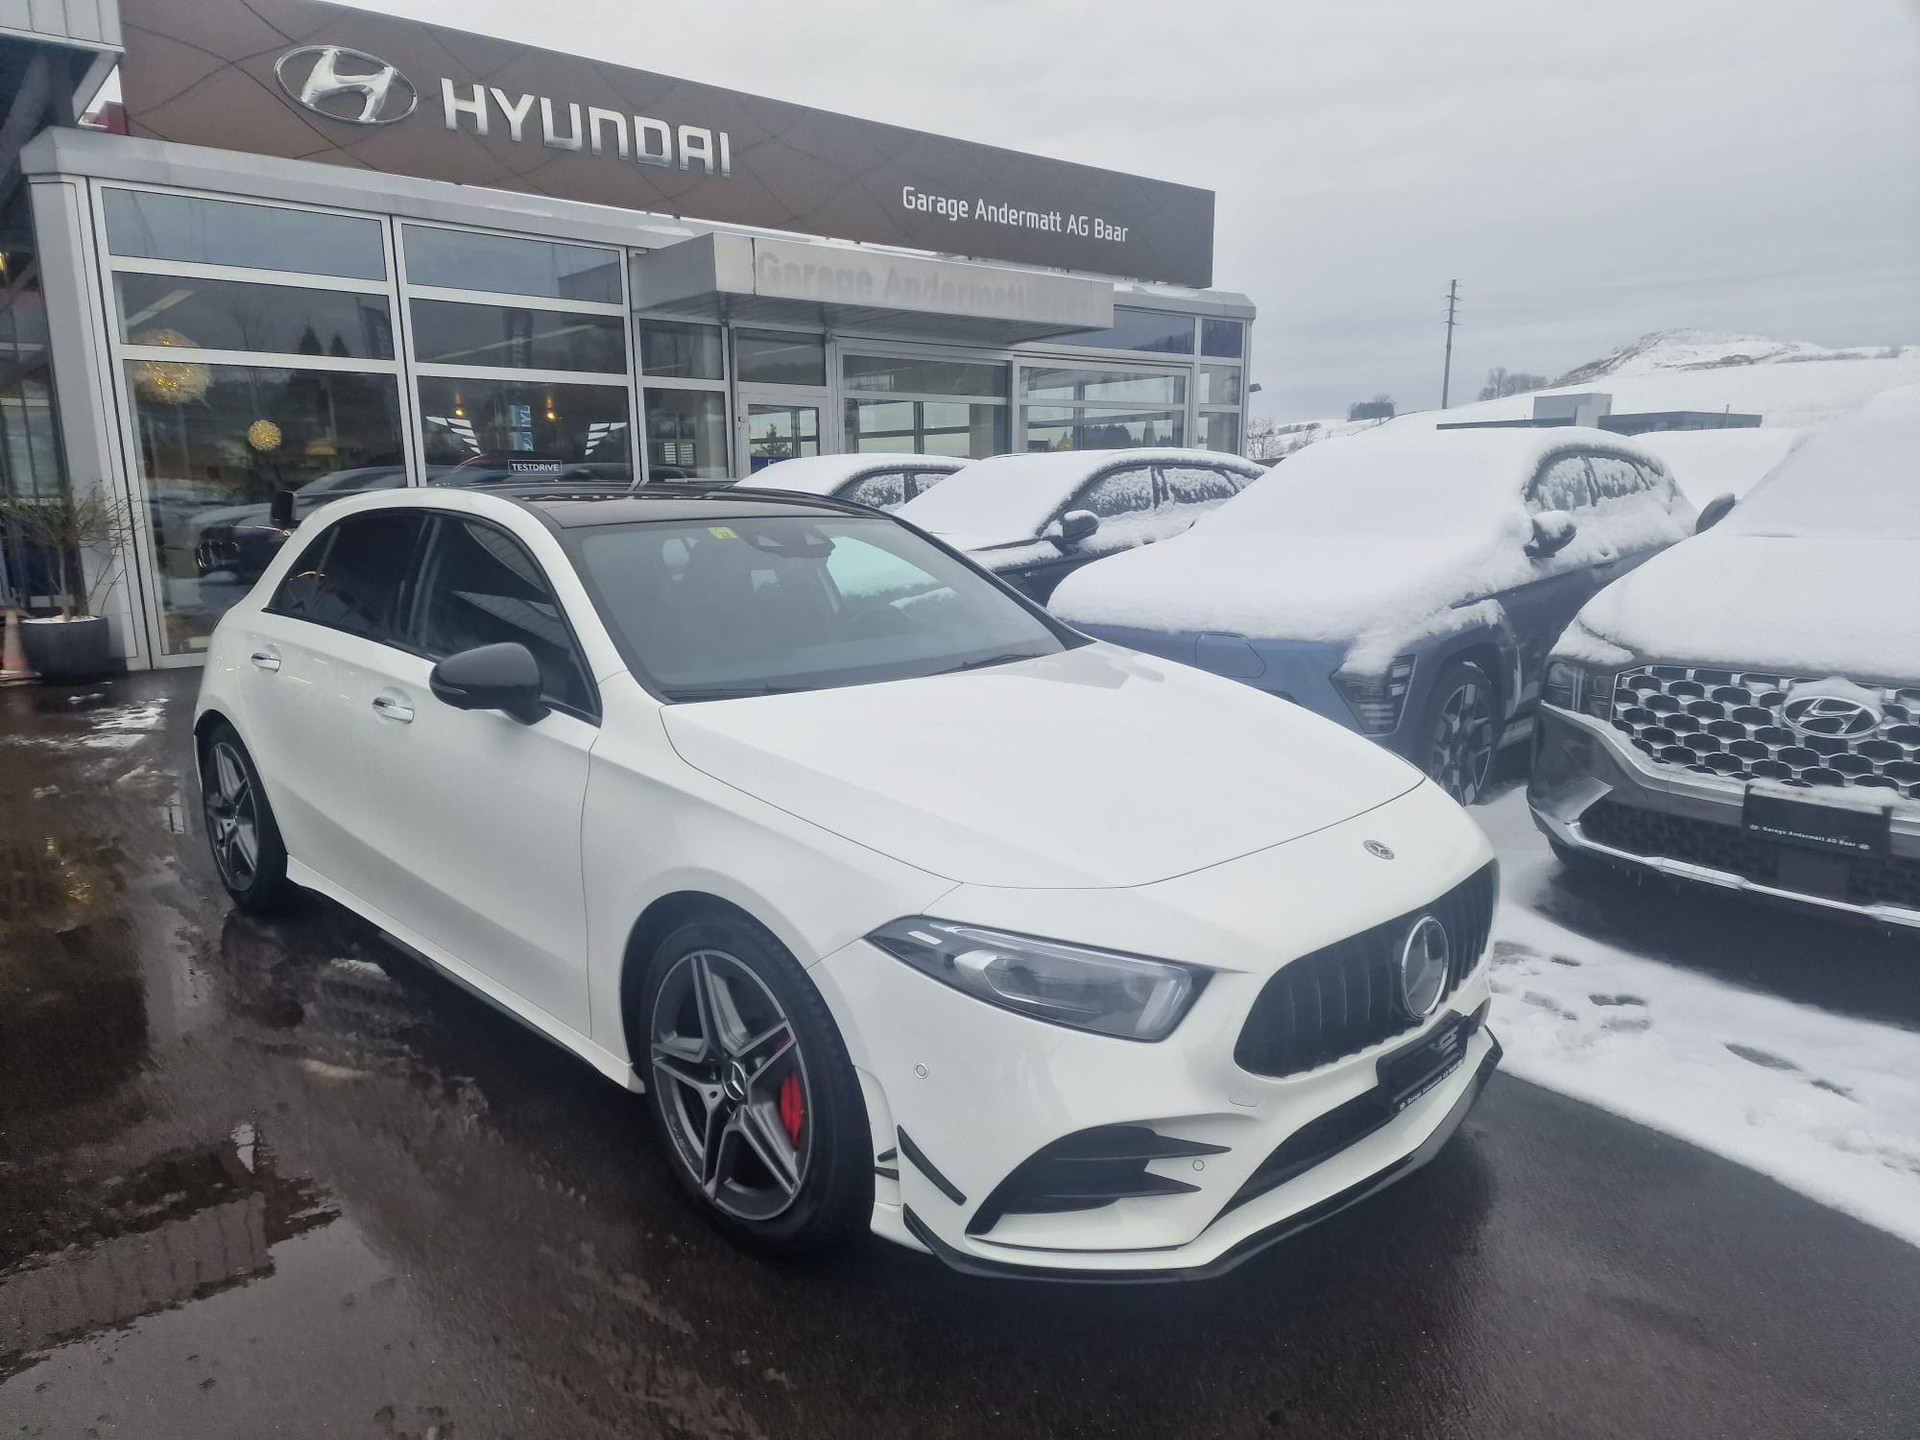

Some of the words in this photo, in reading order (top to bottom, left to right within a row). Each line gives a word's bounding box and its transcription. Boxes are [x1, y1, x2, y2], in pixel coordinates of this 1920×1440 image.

[441, 78, 731, 178] HYUNDAI
[902, 186, 969, 221] Garage
[975, 199, 1062, 233] Andermatt
[1067, 214, 1089, 236] AG
[1094, 218, 1129, 242] Baar
[511, 463, 559, 471] TESTDRIVE
